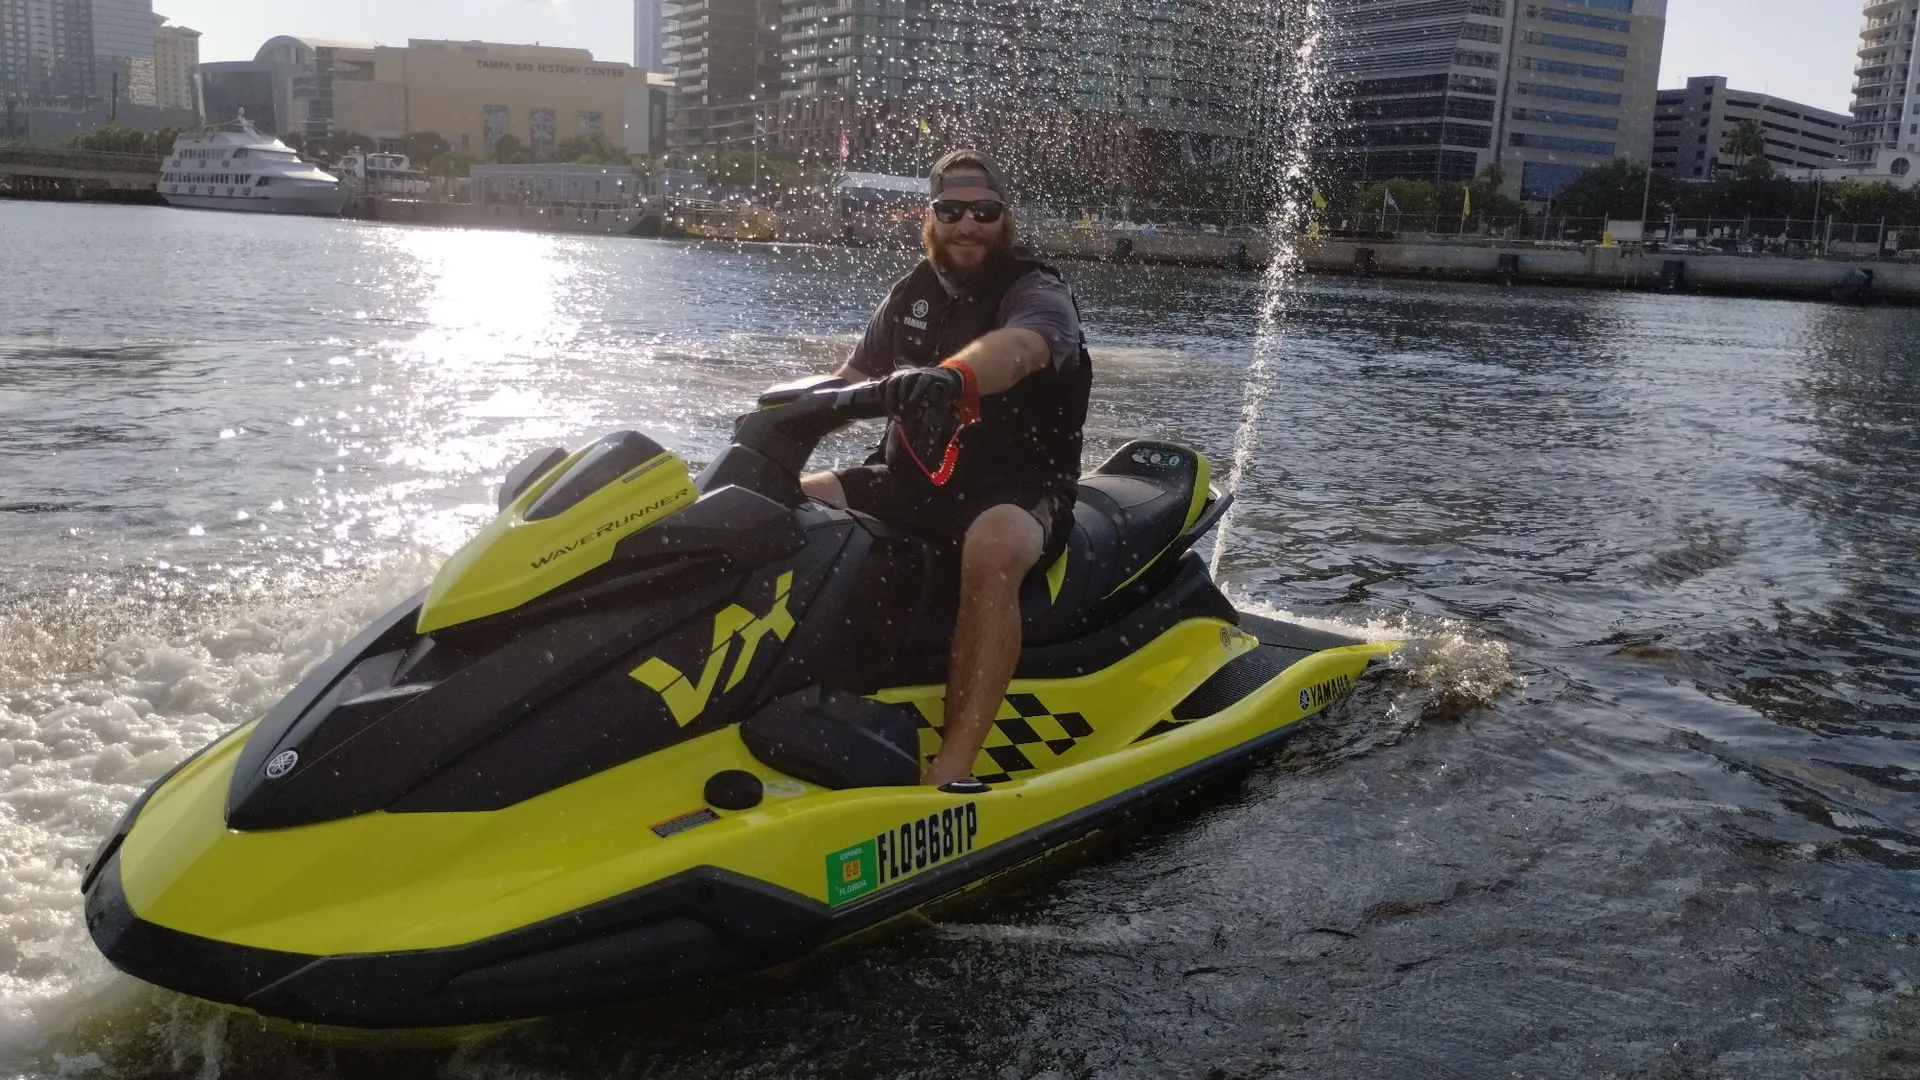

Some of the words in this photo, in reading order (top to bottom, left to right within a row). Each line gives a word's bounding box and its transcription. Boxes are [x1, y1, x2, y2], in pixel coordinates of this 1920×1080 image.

[476, 59, 511, 71] TAMPA
[515, 62, 534, 72] BAY
[538, 63, 581, 75] HISTORY
[585, 67, 624, 78] CENTER
[530, 488, 689, 570] WAVERUNNER
[839, 879, 867, 896] FLORIDA
